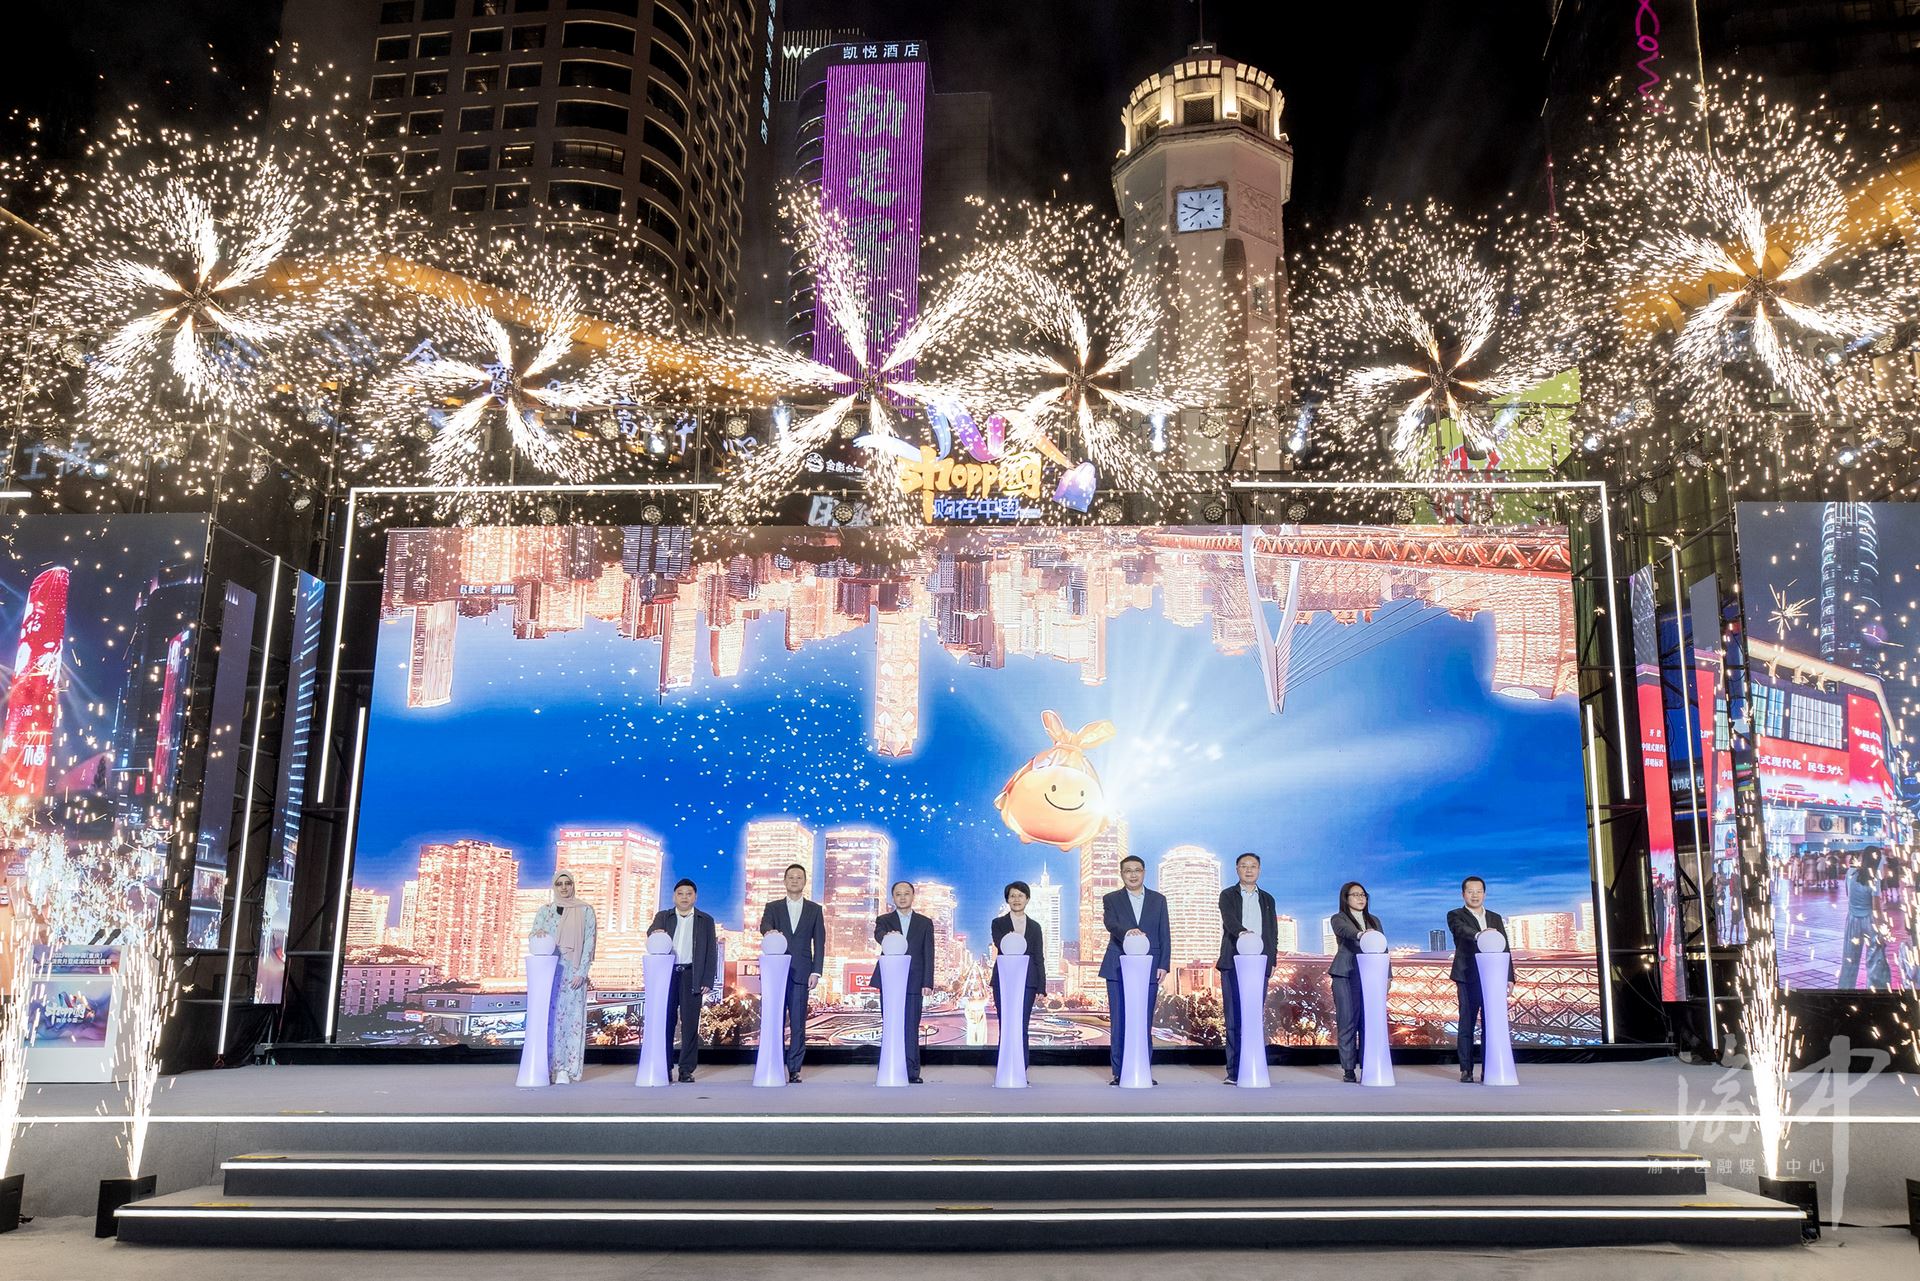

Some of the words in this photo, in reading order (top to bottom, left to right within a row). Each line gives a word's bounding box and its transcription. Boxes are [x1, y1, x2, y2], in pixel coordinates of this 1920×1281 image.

[843, 43, 920, 60] 凯悦酒店
[934, 498, 1020, 519] 购在中国
[1758, 753, 1802, 770] 式现代化
